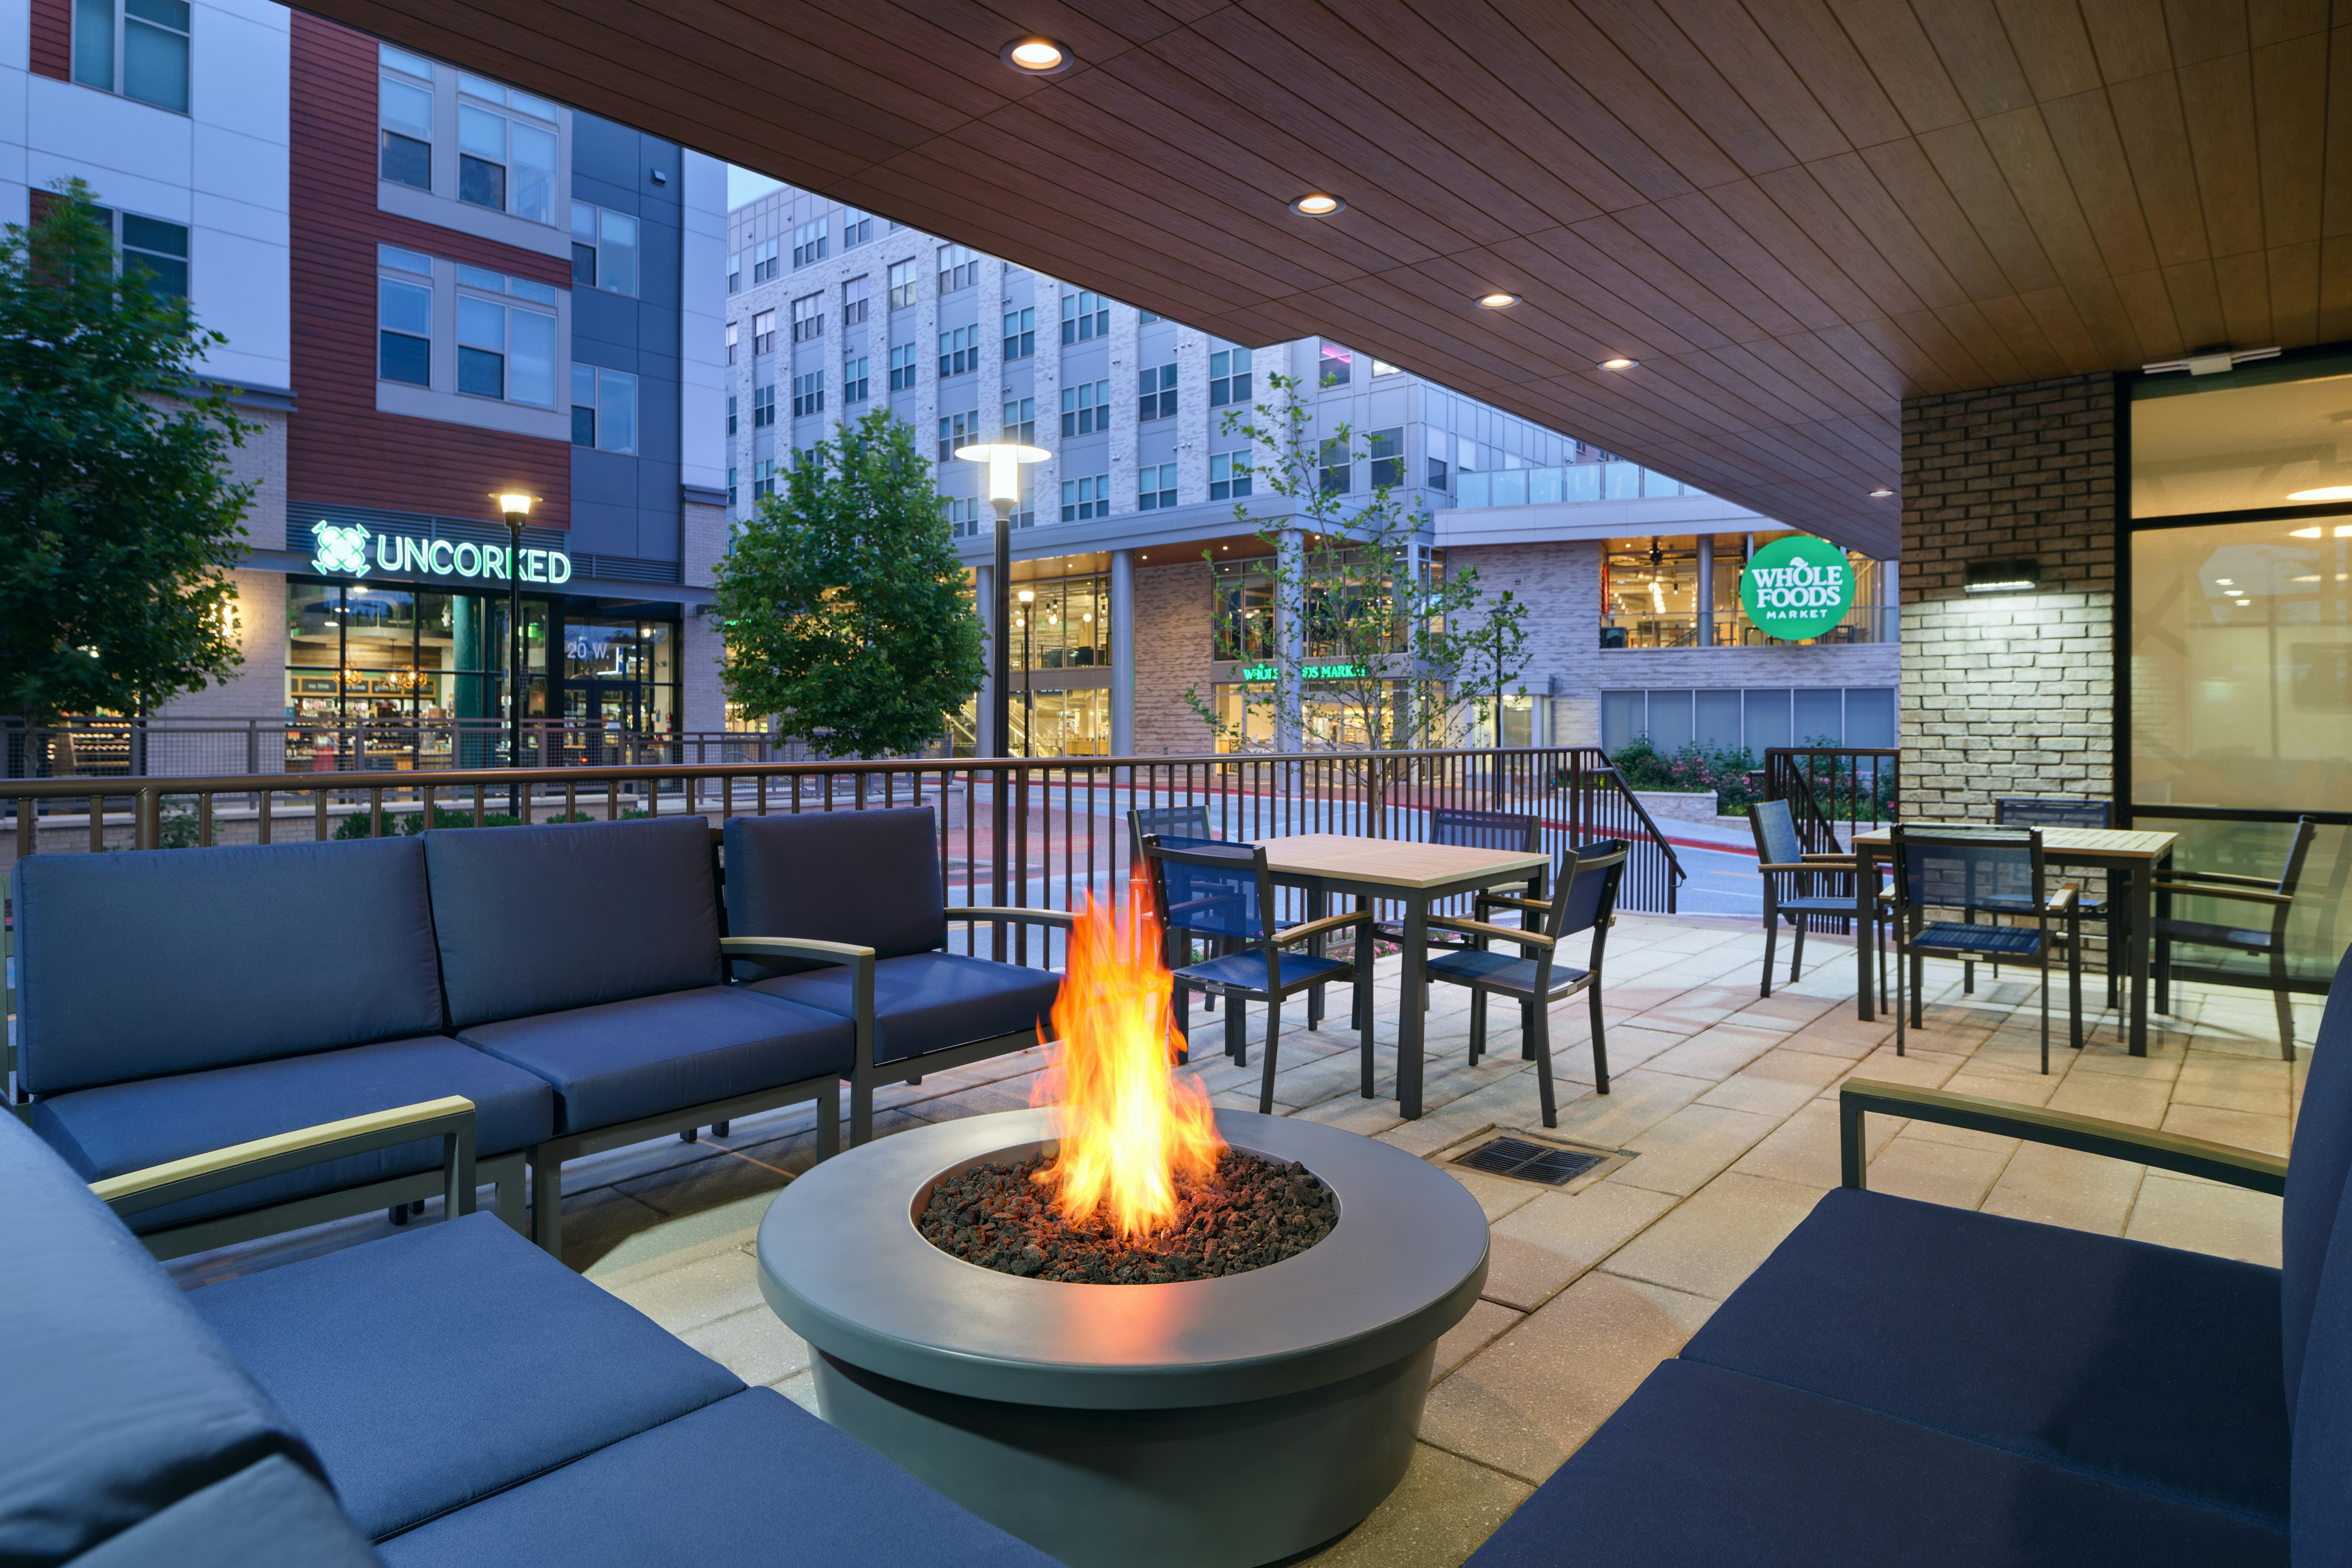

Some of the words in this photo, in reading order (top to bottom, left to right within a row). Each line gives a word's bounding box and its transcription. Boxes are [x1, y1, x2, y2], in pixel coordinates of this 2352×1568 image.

[377, 533, 571, 584] UNCORKED
[1751, 565, 1843, 589] WHOLE
[1756, 586, 1841, 608] FOODS
[1766, 609, 1828, 620] MARKET
[567, 642, 587, 659] 20
[592, 642, 610, 659] W.
